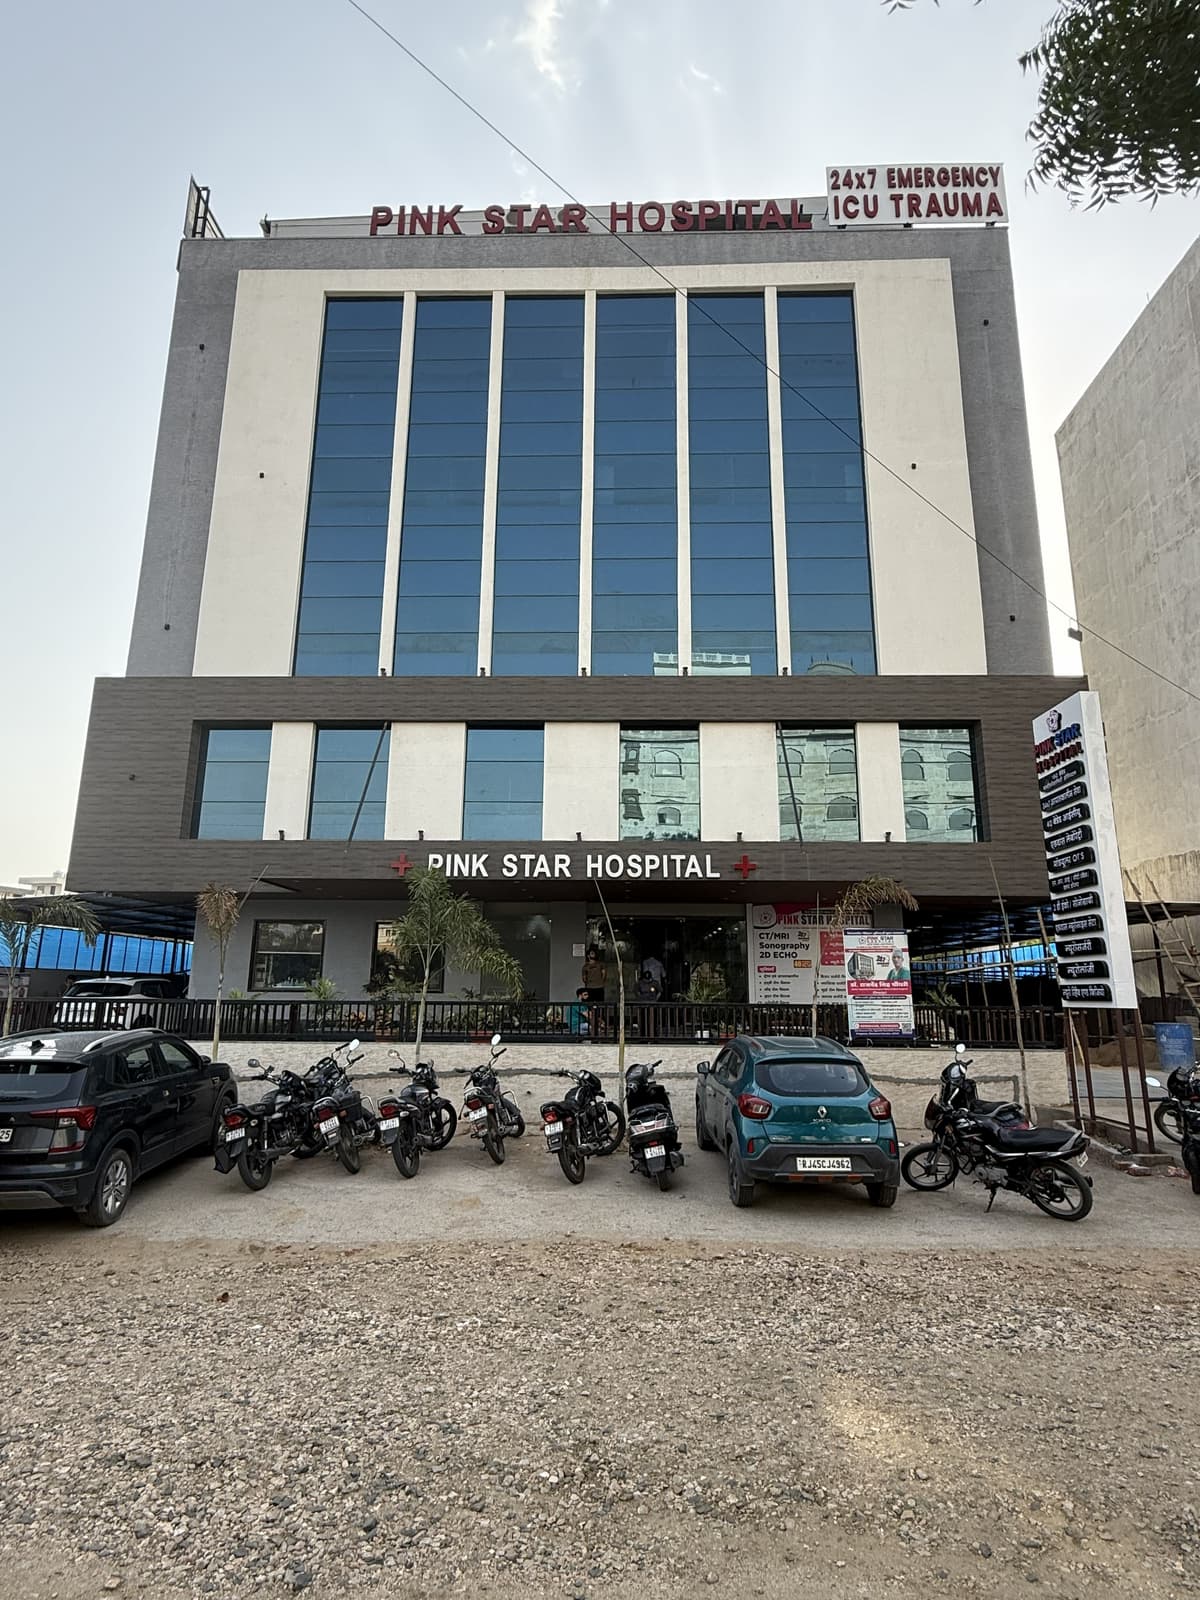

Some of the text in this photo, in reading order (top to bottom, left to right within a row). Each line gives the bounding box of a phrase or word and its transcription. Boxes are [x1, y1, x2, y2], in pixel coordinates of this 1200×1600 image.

[830, 166, 1000, 190] 24x7 EMERGENCY
[833, 192, 1004, 219] ICU TRAUMA
[369, 199, 813, 236] PINK STAR HOSPITAL
[1034, 736, 1057, 758] PINK
[428, 854, 720, 878] PINK STAR HOSPITAL
[801, 914, 824, 924] STAR
[759, 942, 810, 950] Sonography
[802, 1159, 850, 1169] RJ45CJ4962
